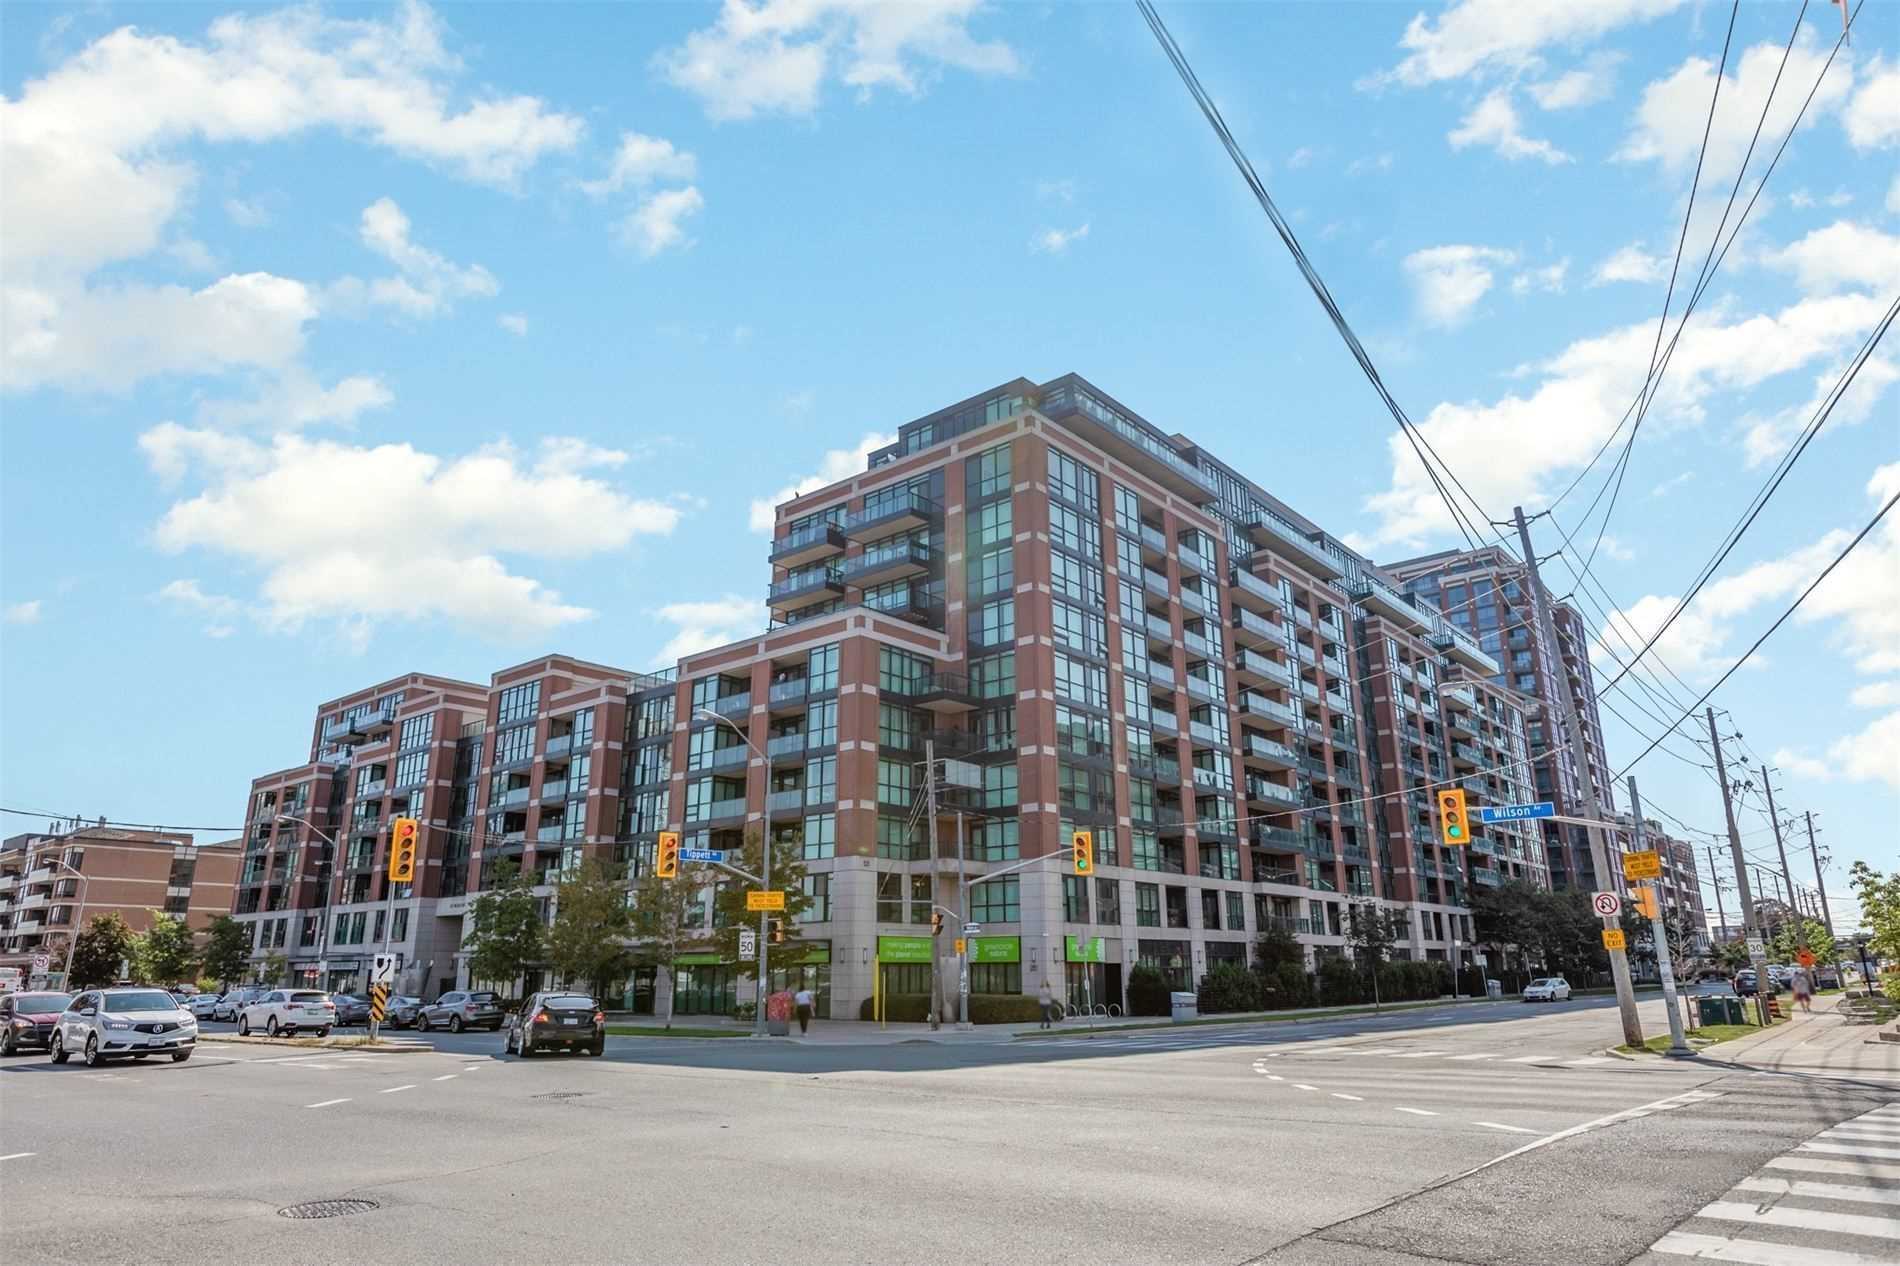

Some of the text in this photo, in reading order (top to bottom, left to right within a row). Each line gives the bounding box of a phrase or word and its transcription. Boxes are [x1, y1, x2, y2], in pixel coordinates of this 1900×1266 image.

[1493, 807, 1530, 818] Wilson
[686, 850, 711, 860] Tippett
[741, 942, 753, 953] 50
[1750, 944, 1762, 953] 30
